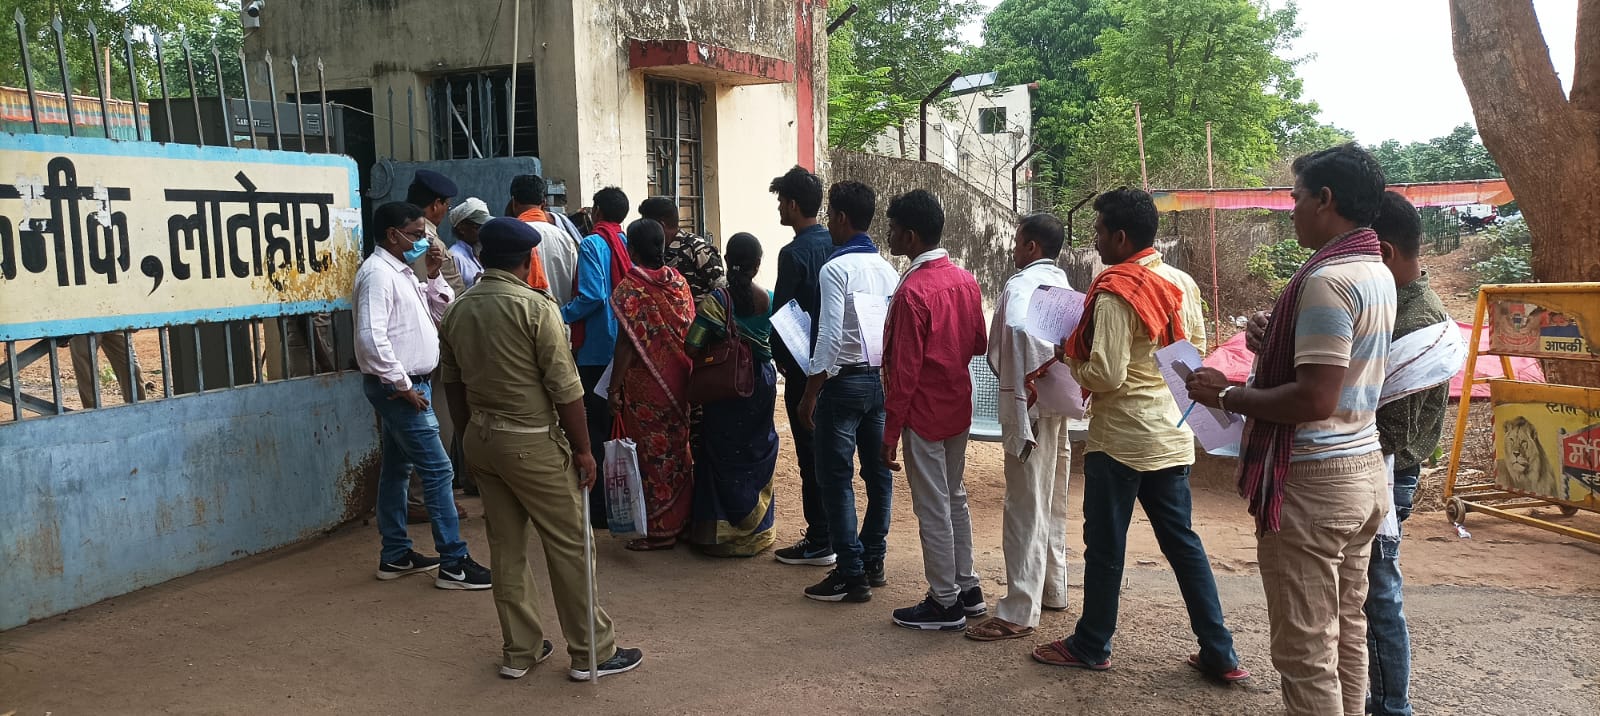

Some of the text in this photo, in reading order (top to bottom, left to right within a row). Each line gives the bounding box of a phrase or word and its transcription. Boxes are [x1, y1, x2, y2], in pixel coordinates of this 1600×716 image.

[236, 118, 260, 127] GARTT
[164, 171, 334, 291] लातेहार
[1544, 338, 1582, 352] आपकी
